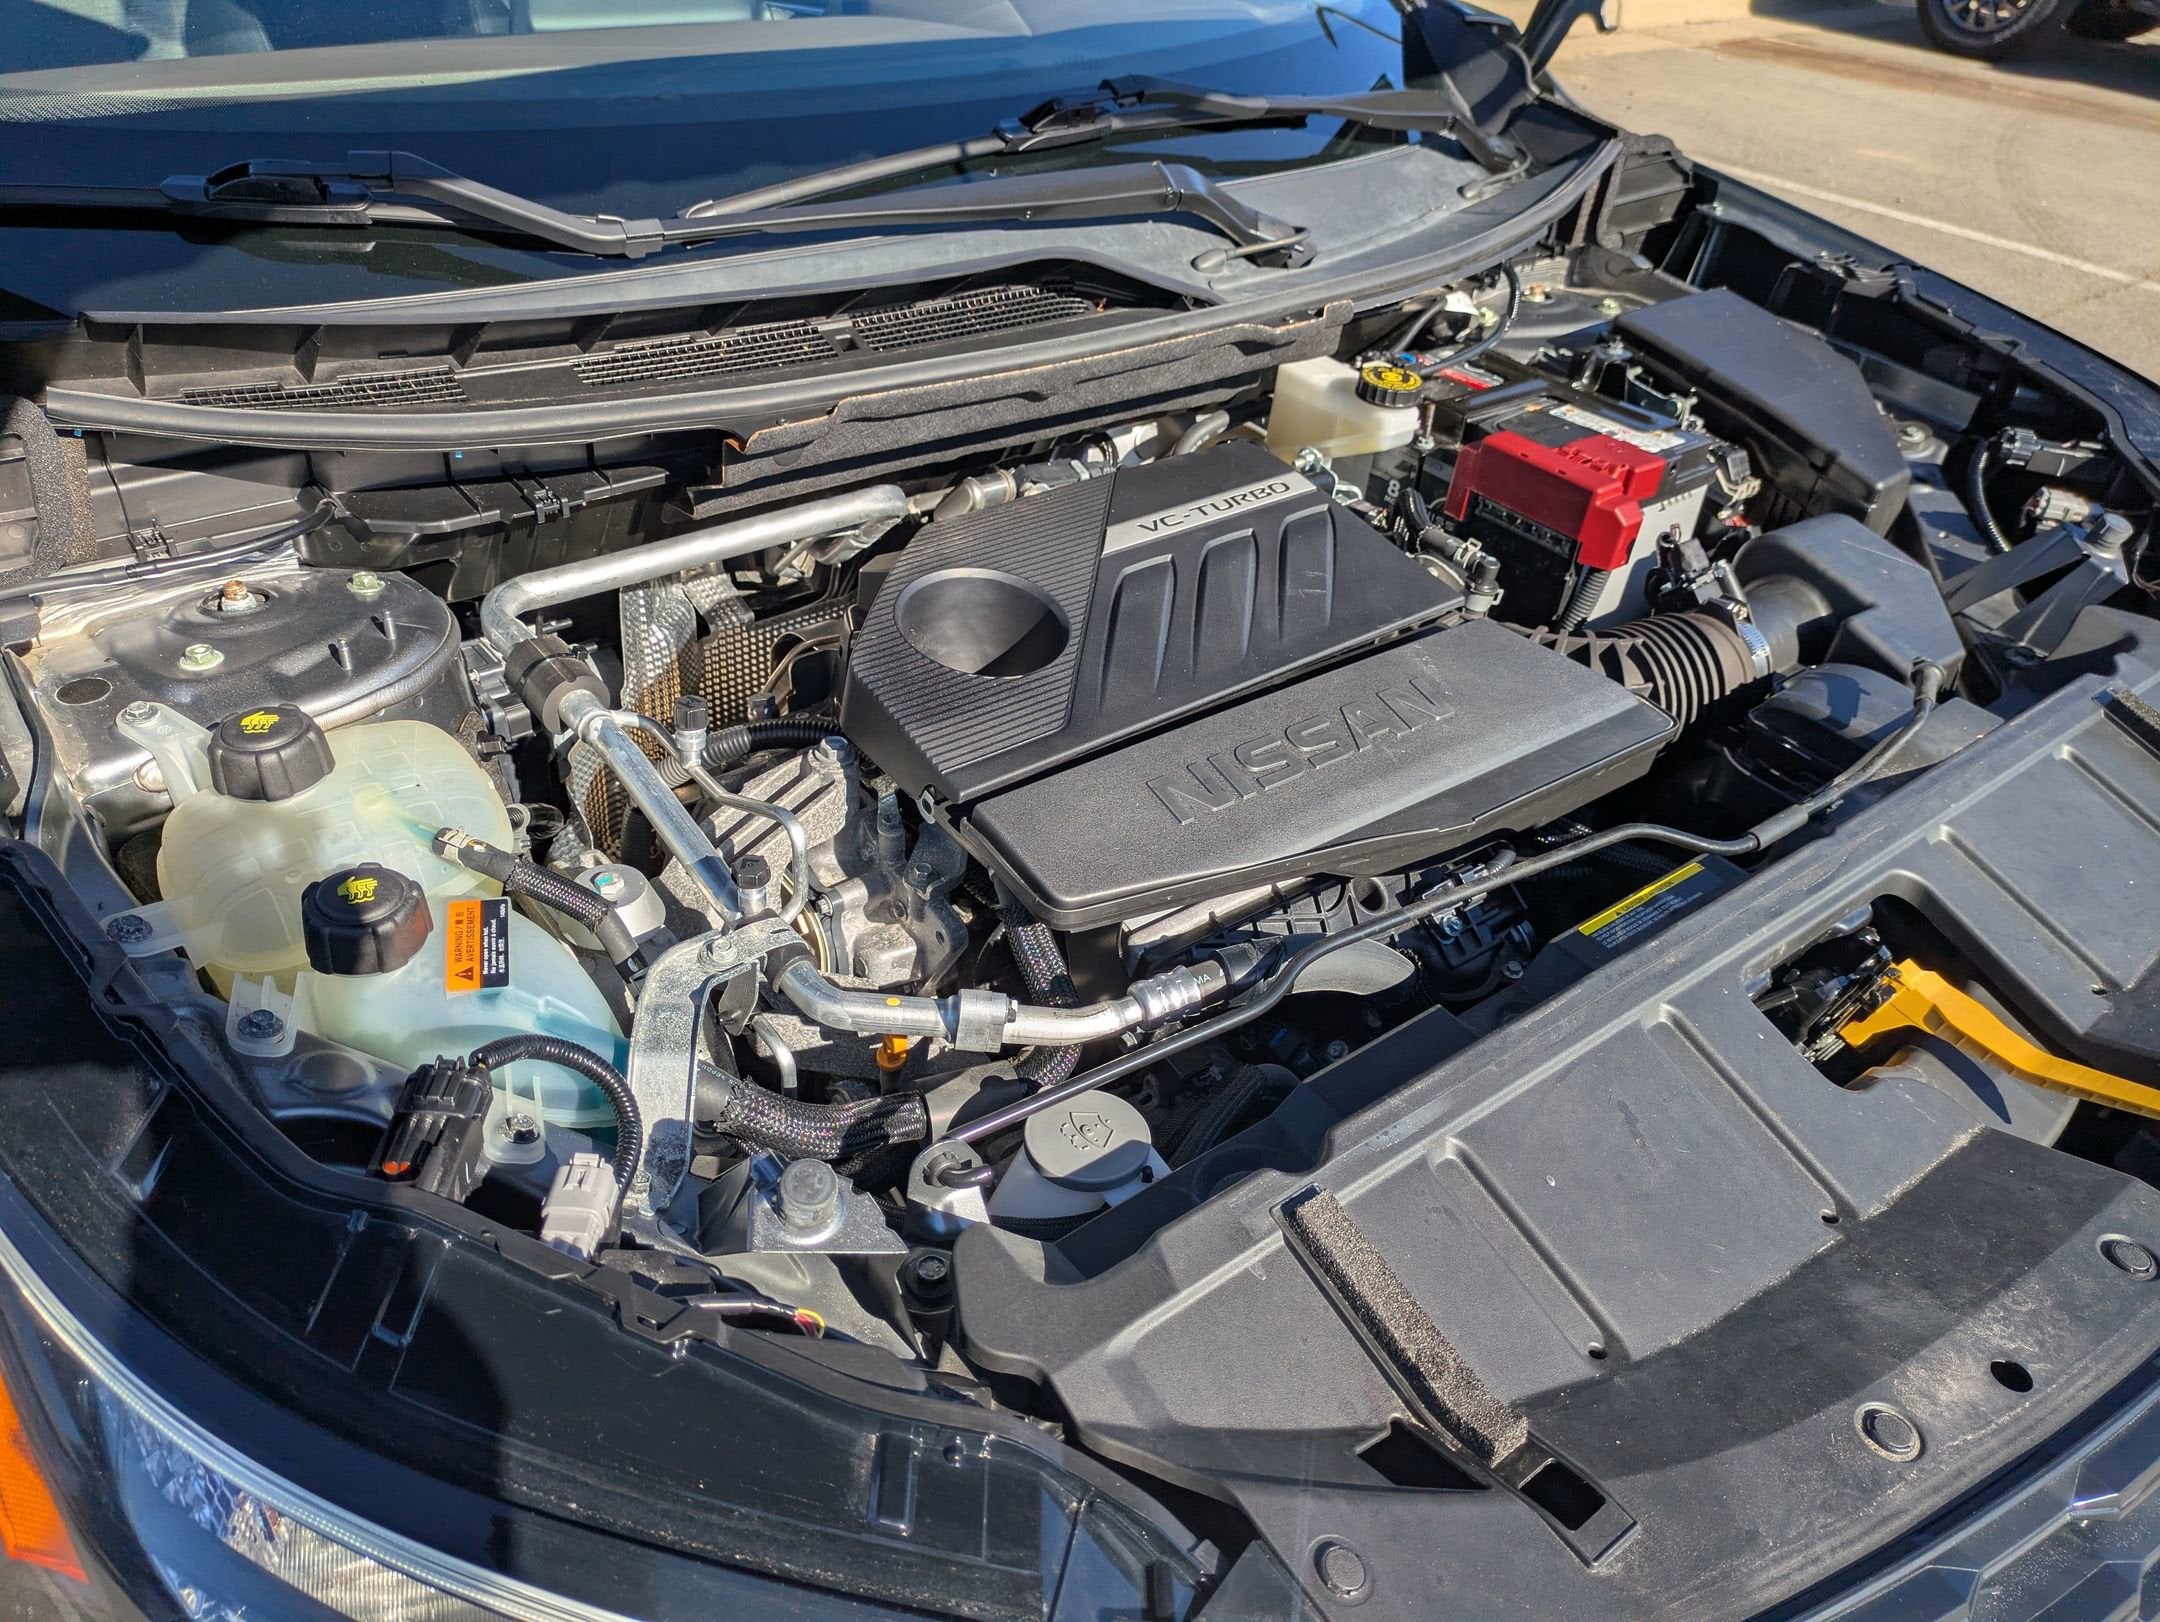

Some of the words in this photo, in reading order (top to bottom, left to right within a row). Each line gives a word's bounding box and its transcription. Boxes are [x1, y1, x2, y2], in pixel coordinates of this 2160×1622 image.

[1136, 481, 1290, 532] VC-TURBO
[1145, 677, 1456, 825] NISSAN
[455, 929, 464, 963] WARNING
[466, 907, 475, 962] AVERTISSEMENT
